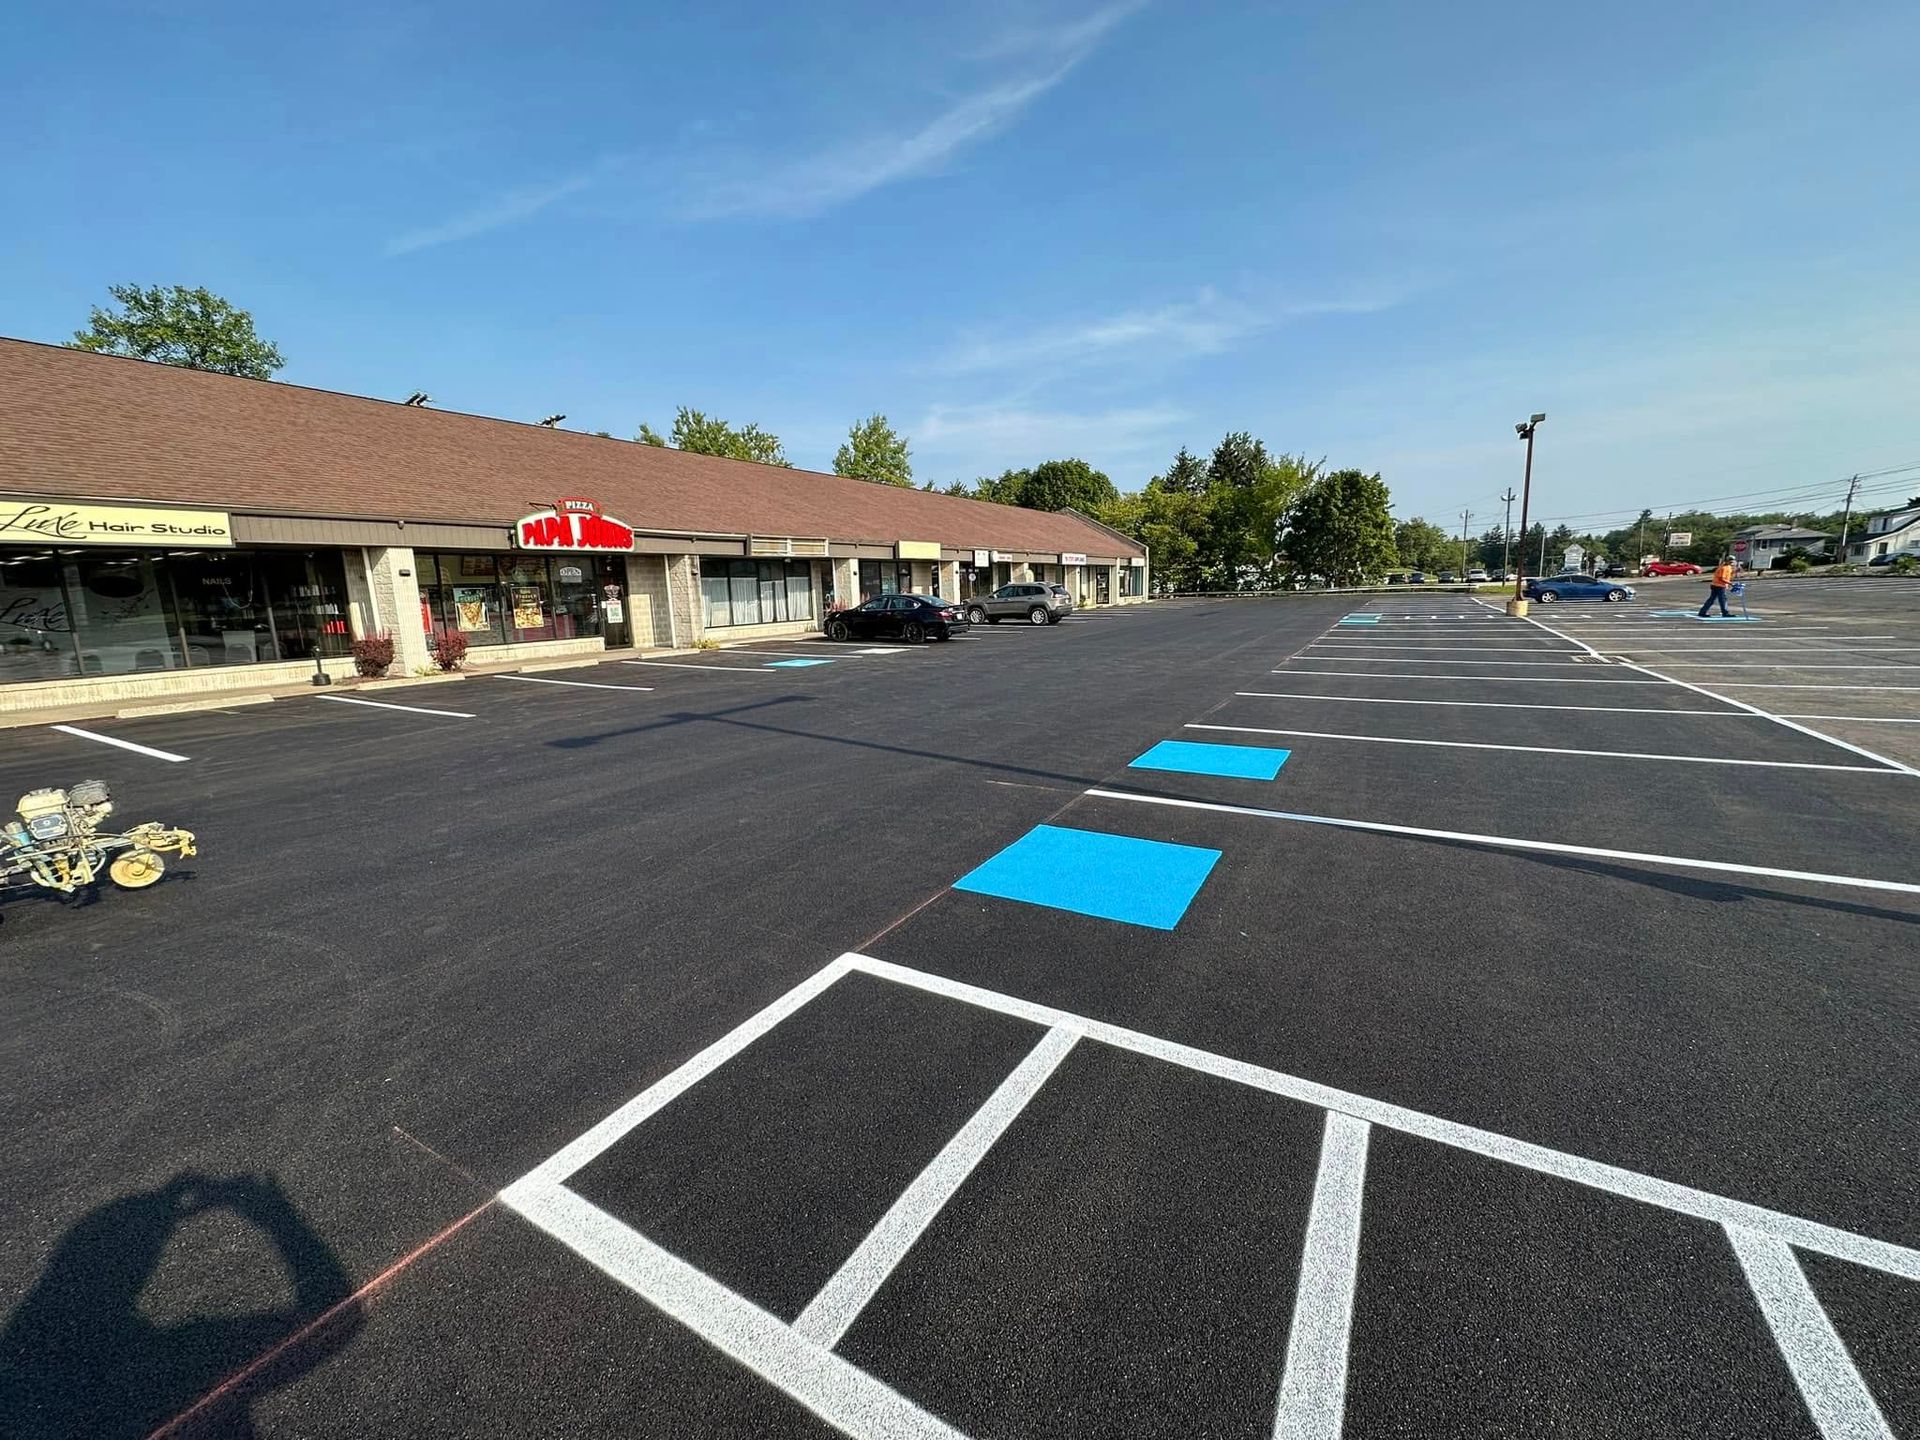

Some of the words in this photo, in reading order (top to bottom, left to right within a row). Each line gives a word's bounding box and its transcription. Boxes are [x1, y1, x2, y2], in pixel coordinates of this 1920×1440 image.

[564, 500, 594, 511] PIZZA
[89, 521, 145, 532] Hair
[151, 523, 226, 535] Studio
[522, 516, 575, 547] PAPA
[202, 577, 233, 585] NAILS
